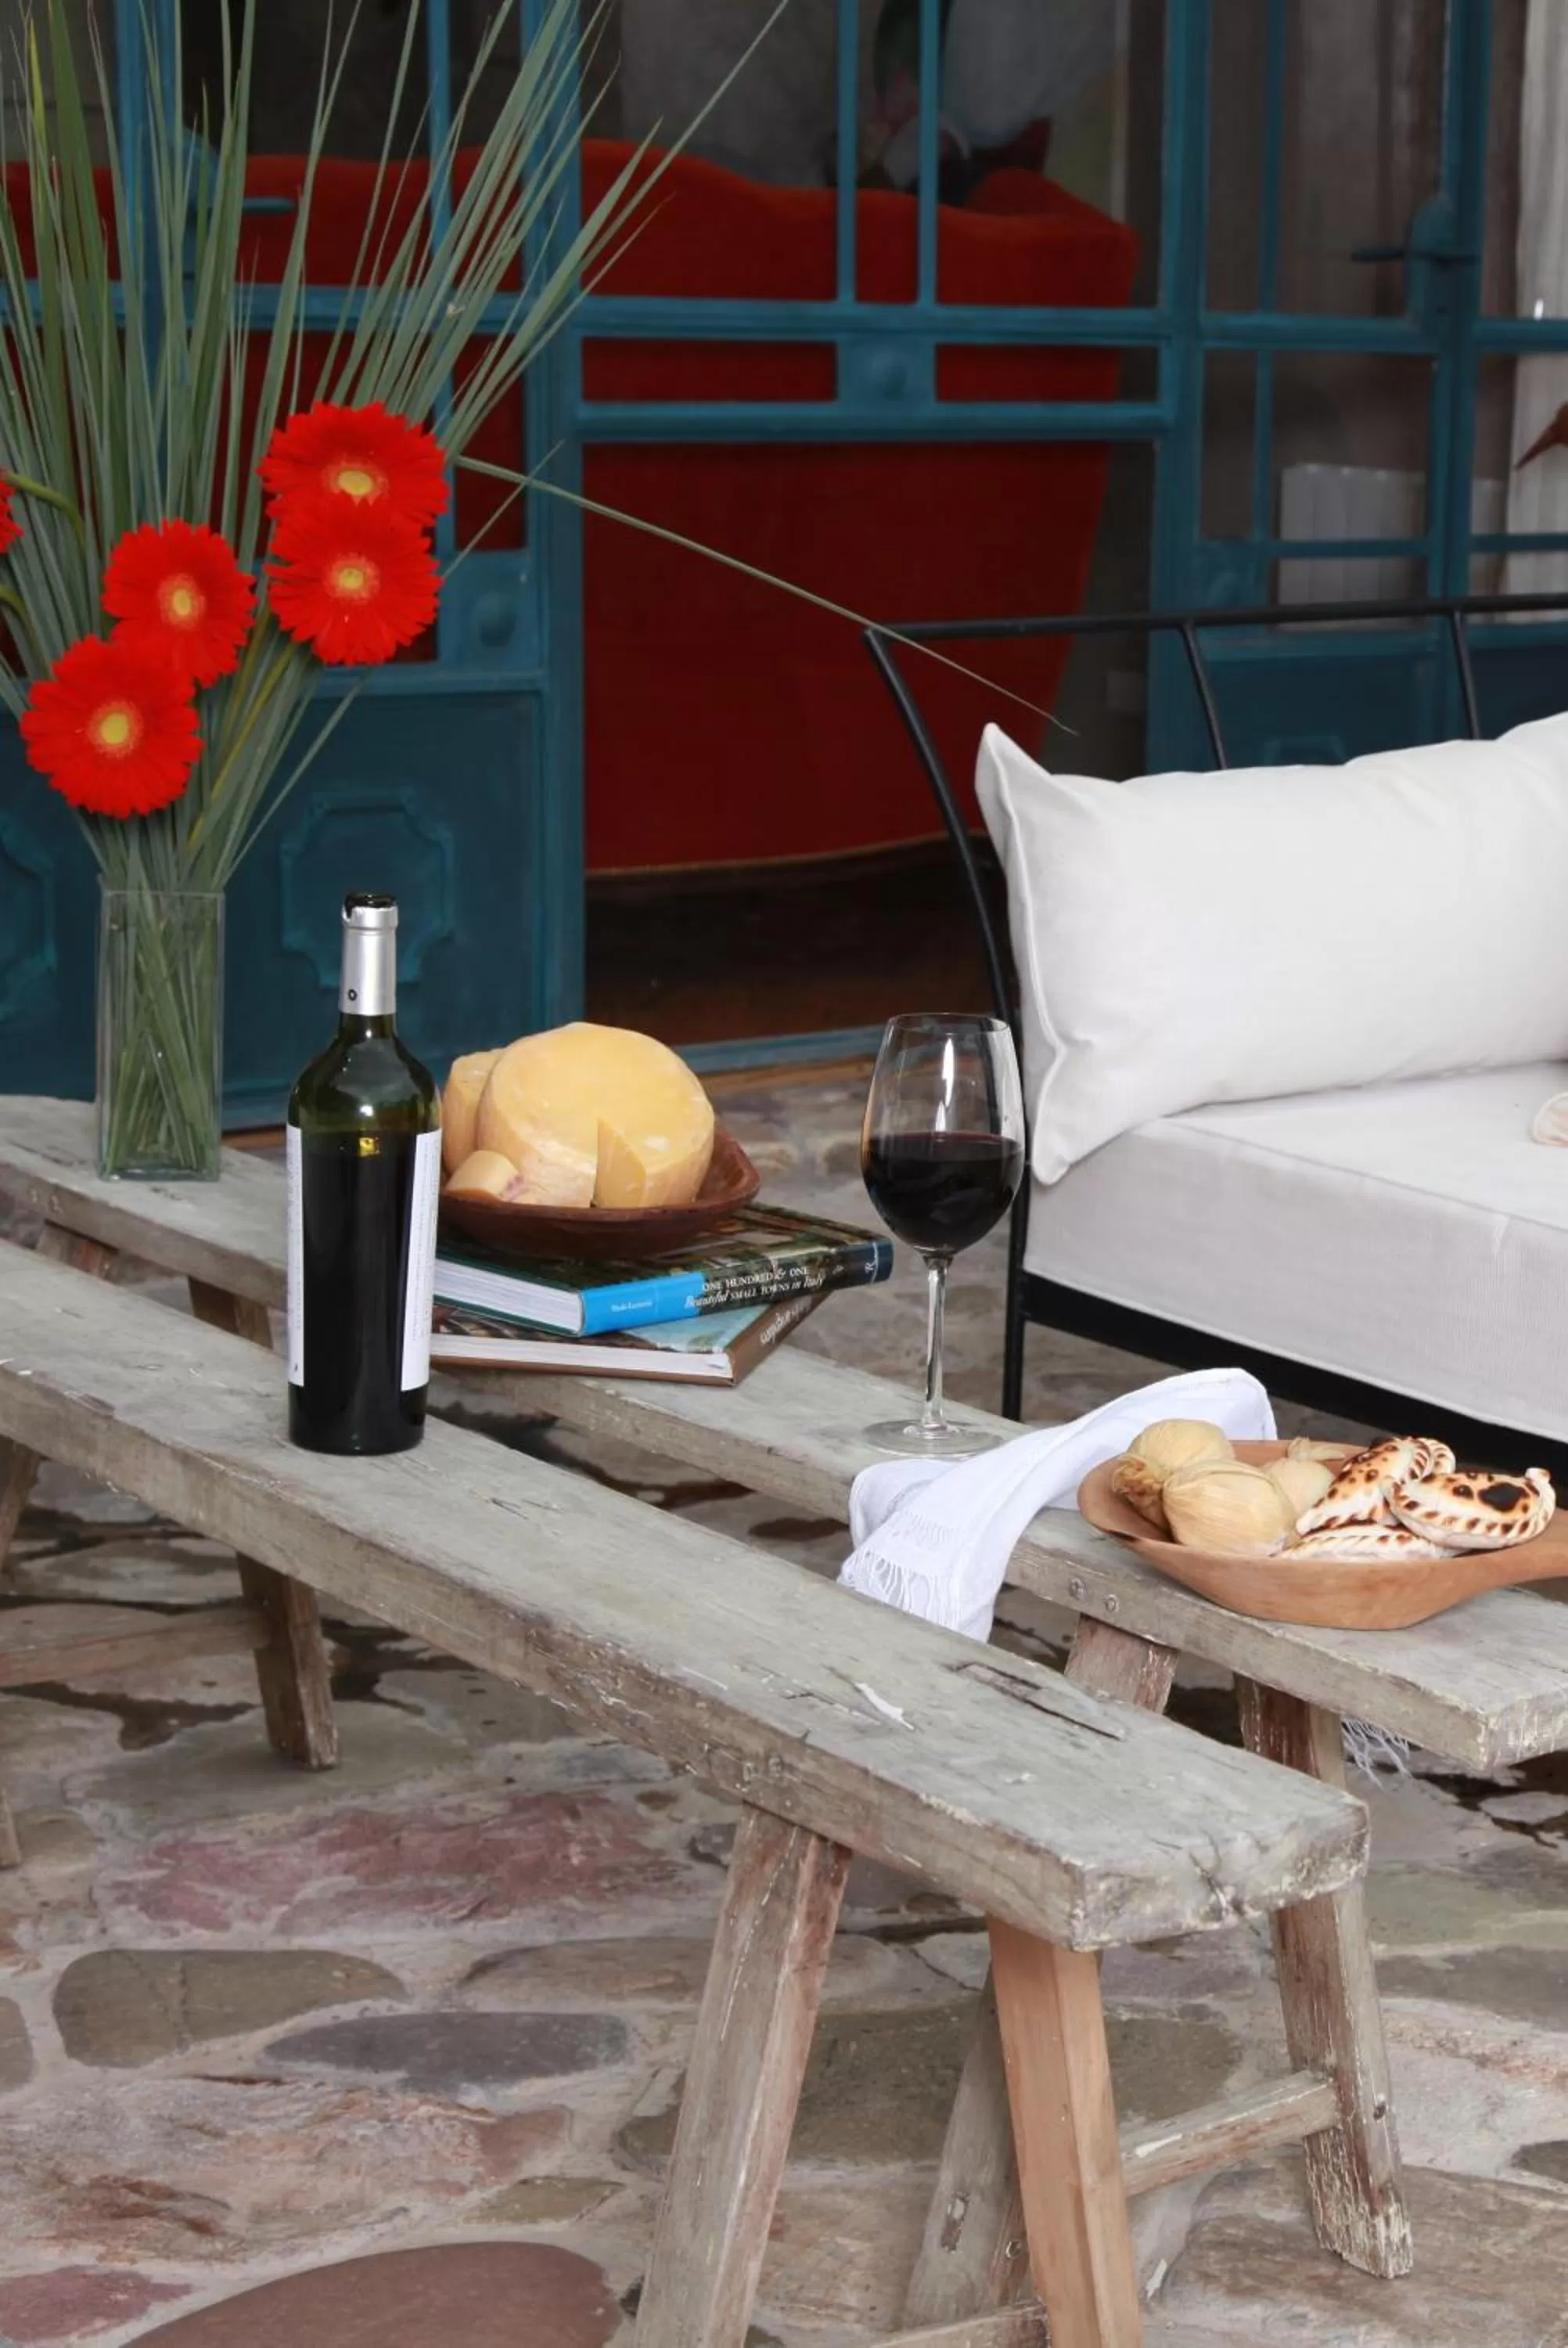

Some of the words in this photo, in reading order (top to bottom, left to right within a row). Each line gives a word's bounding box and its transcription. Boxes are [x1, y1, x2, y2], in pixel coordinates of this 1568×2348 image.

[685, 1290, 729, 1309] Beautiful
[730, 1288, 757, 1302] SMALL
[761, 1282, 789, 1298] TOWNS
[791, 1278, 801, 1290] in
[804, 1273, 825, 1288] Italy
[702, 1281, 724, 1291] ONE
[725, 1271, 773, 1289] HUNDRED
[774, 1269, 786, 1280] &
[789, 1266, 811, 1277] ONE
